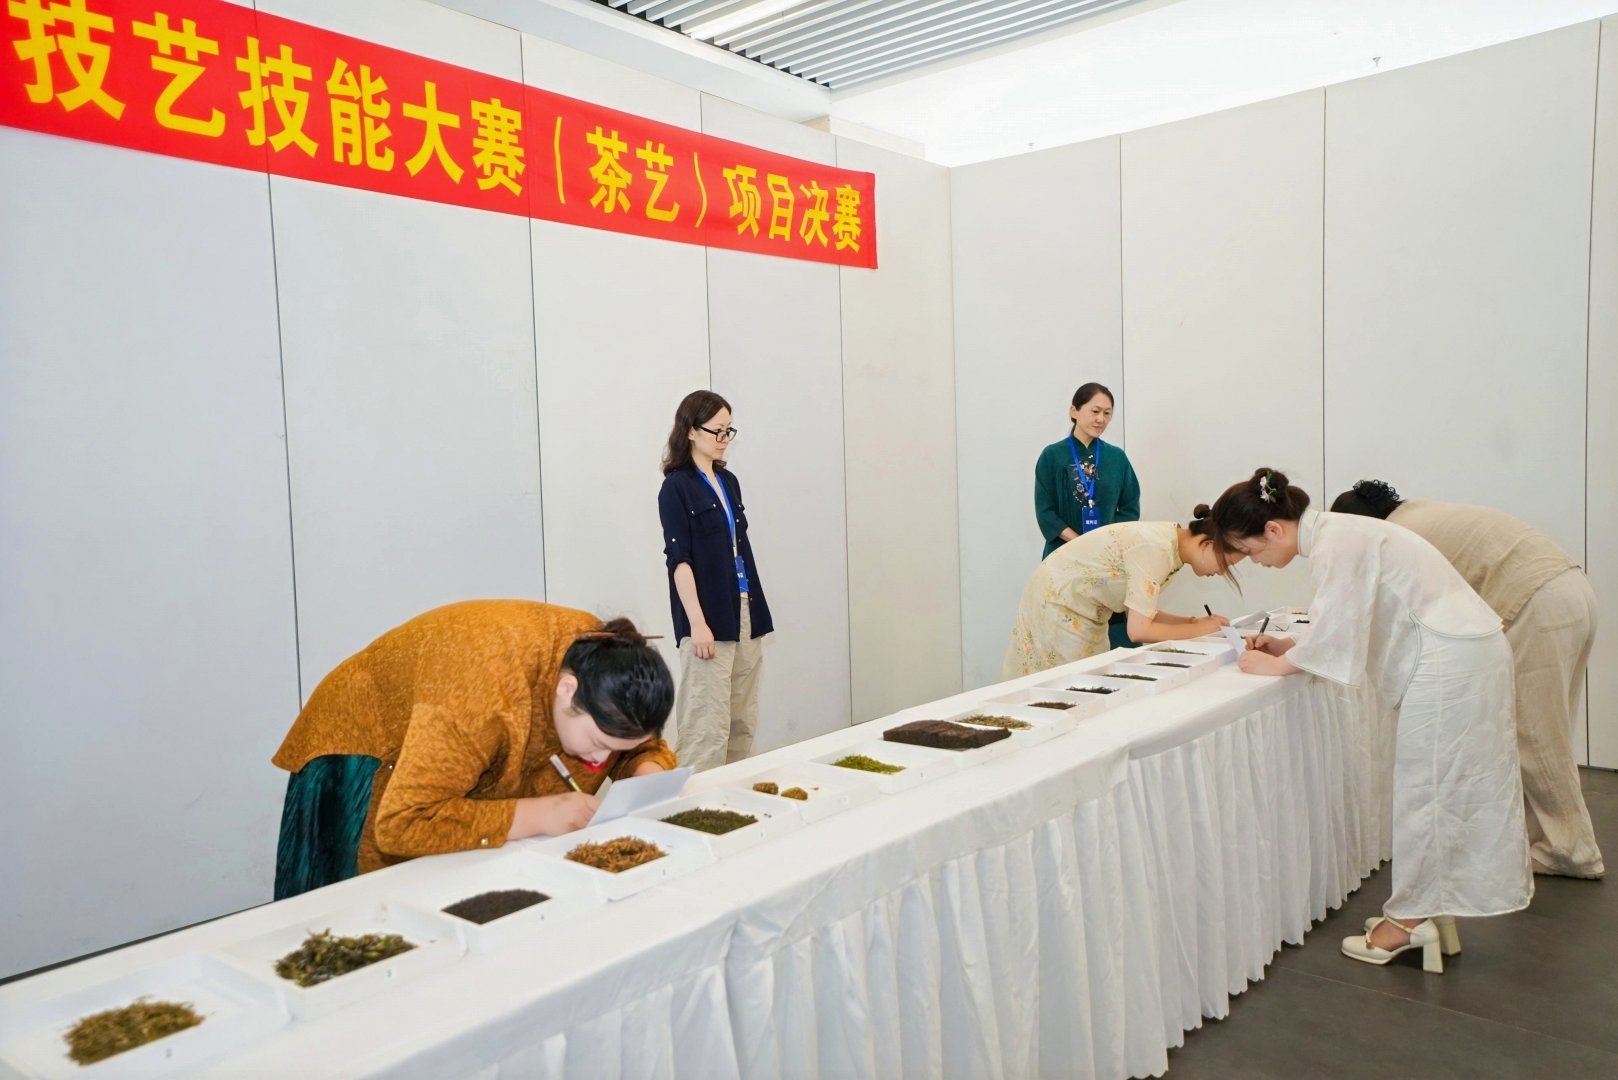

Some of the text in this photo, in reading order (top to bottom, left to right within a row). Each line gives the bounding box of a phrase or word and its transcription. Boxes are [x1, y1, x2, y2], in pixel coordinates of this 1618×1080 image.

[8, 0, 862, 252] 技艺技能大赛（茶艺）项目决赛
